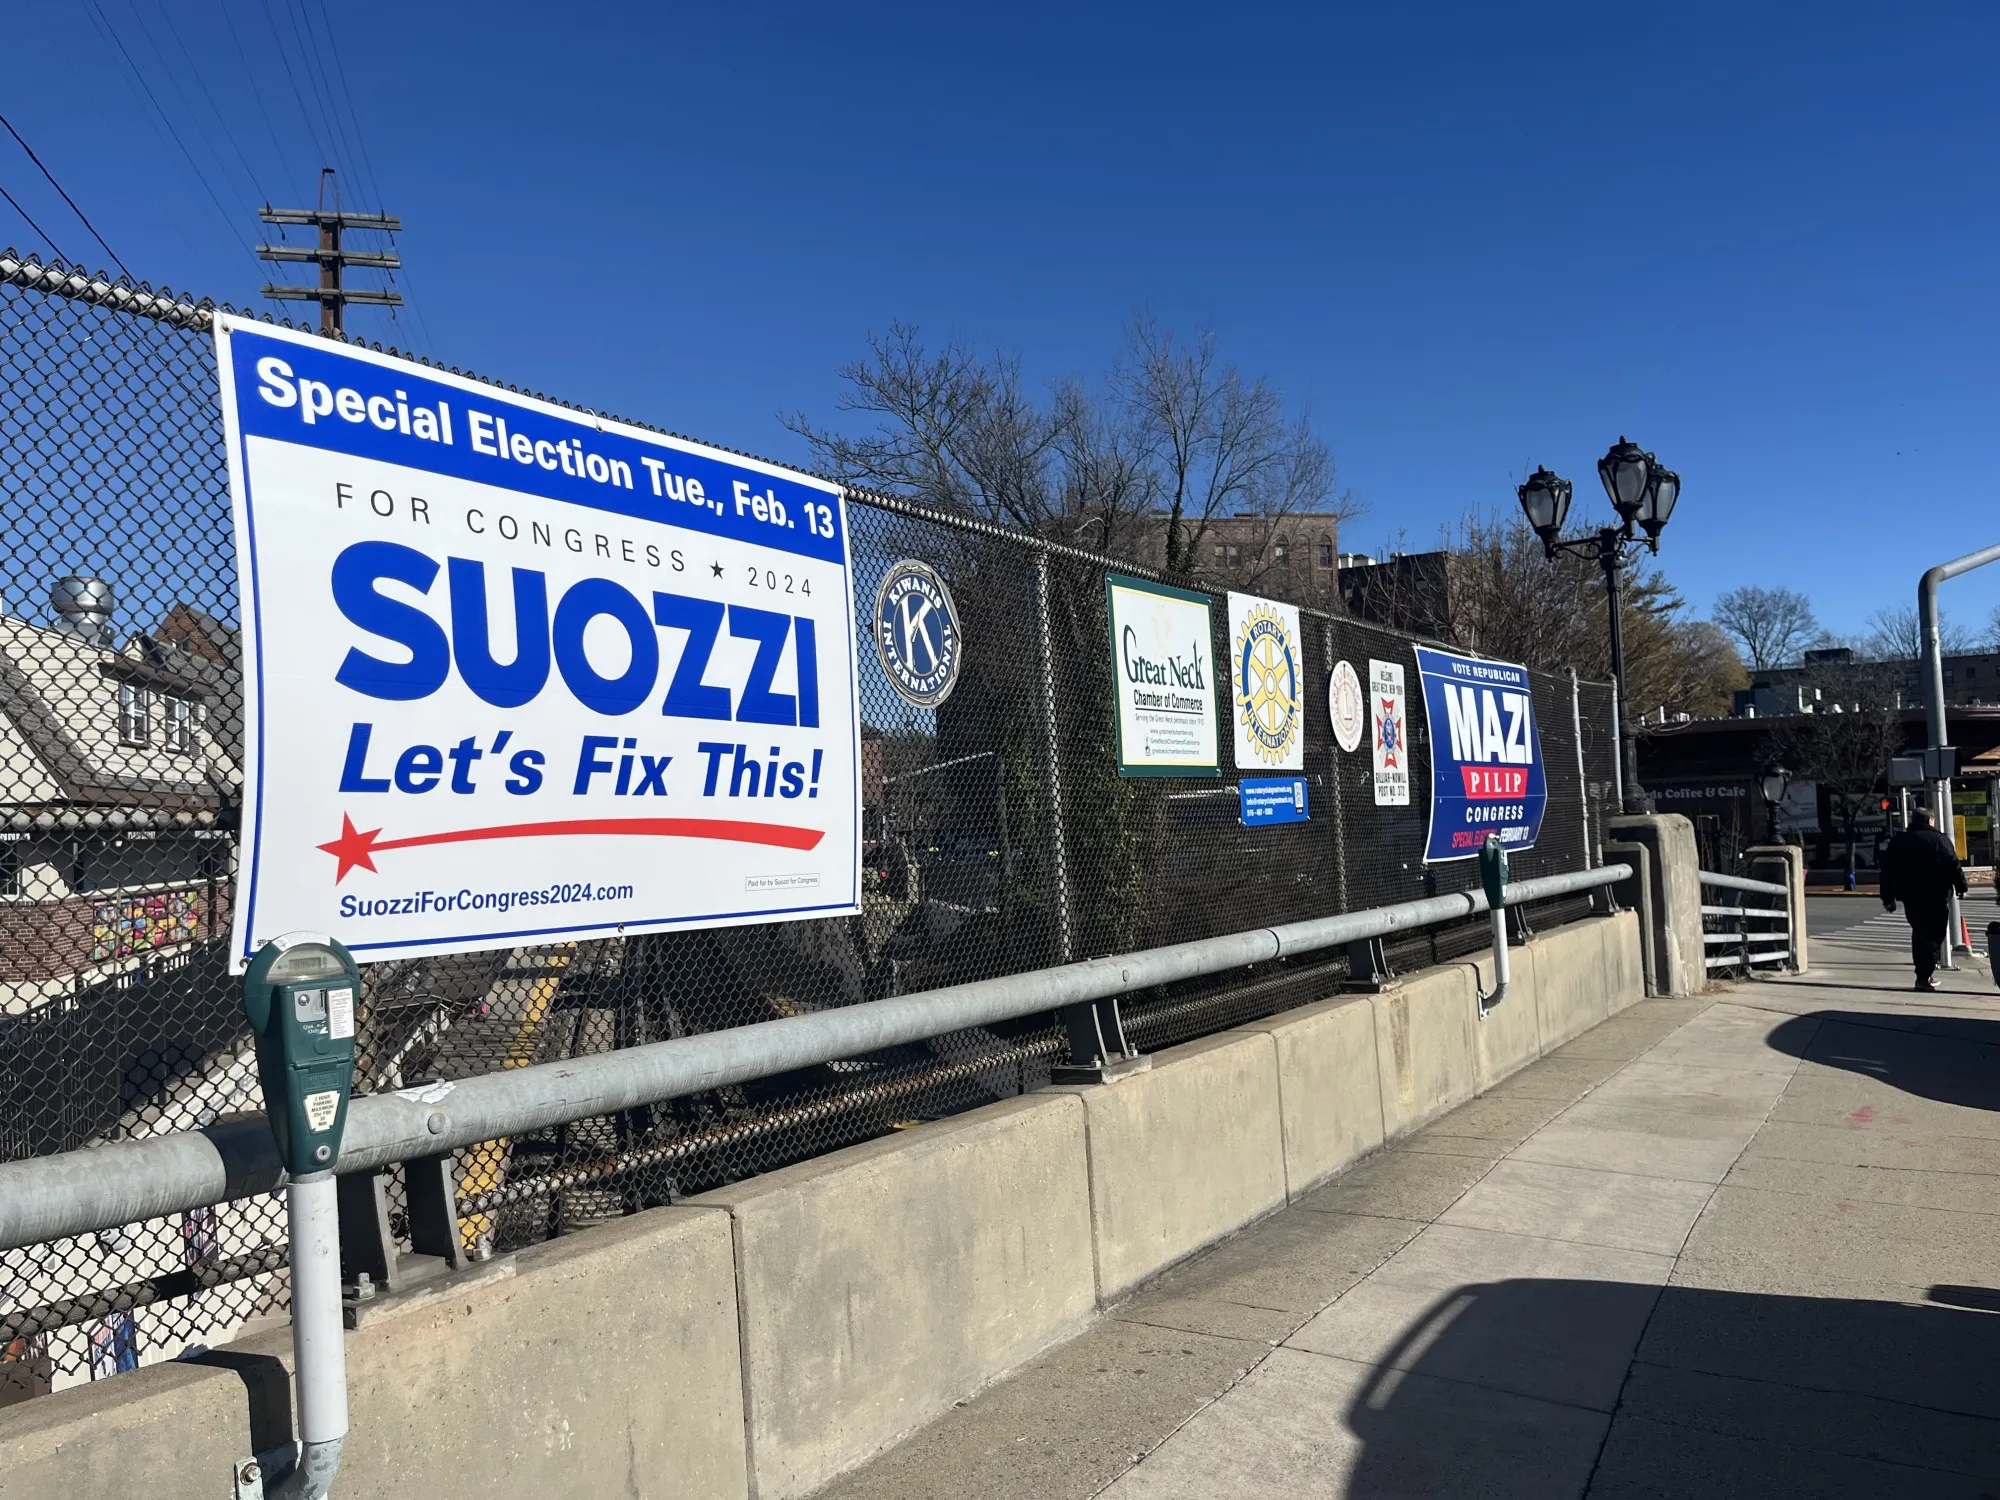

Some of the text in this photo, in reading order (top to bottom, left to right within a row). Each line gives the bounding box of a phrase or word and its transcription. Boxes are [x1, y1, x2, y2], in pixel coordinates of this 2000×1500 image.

[256, 356, 835, 539] Special Election Tue., Feb. 13
[335, 482, 812, 598] FOR CONGRESS 2024
[889, 577, 942, 609] KIWANIS
[331, 540, 819, 728] SUOZZI
[901, 595, 938, 674] K
[1252, 620, 1282, 640] ROTARY
[883, 620, 952, 692] INTERNATIONAL
[1123, 624, 1205, 690] Great Neck
[1452, 662, 1520, 683] VOTE REPUBLICAN
[1133, 689, 1203, 711] Chamber of Commerce
[1247, 709, 1295, 748] INTERNATIONAL
[1443, 682, 1534, 765] MAZI
[338, 722, 824, 798] Let’s Fix This!
[1470, 771, 1522, 793] PILIP
[1665, 788, 1703, 799] Coffee
[1705, 787, 1716, 798] &
[1717, 786, 1746, 797] Cafe
[1466, 805, 1524, 824] CONGRESS
[1452, 831, 1474, 849] SPECIAL
[1500, 826, 1522, 844] FEBRUARY
[1522, 825, 1530, 840] 13
[339, 881, 633, 918] SuozziForCongress2024.com
